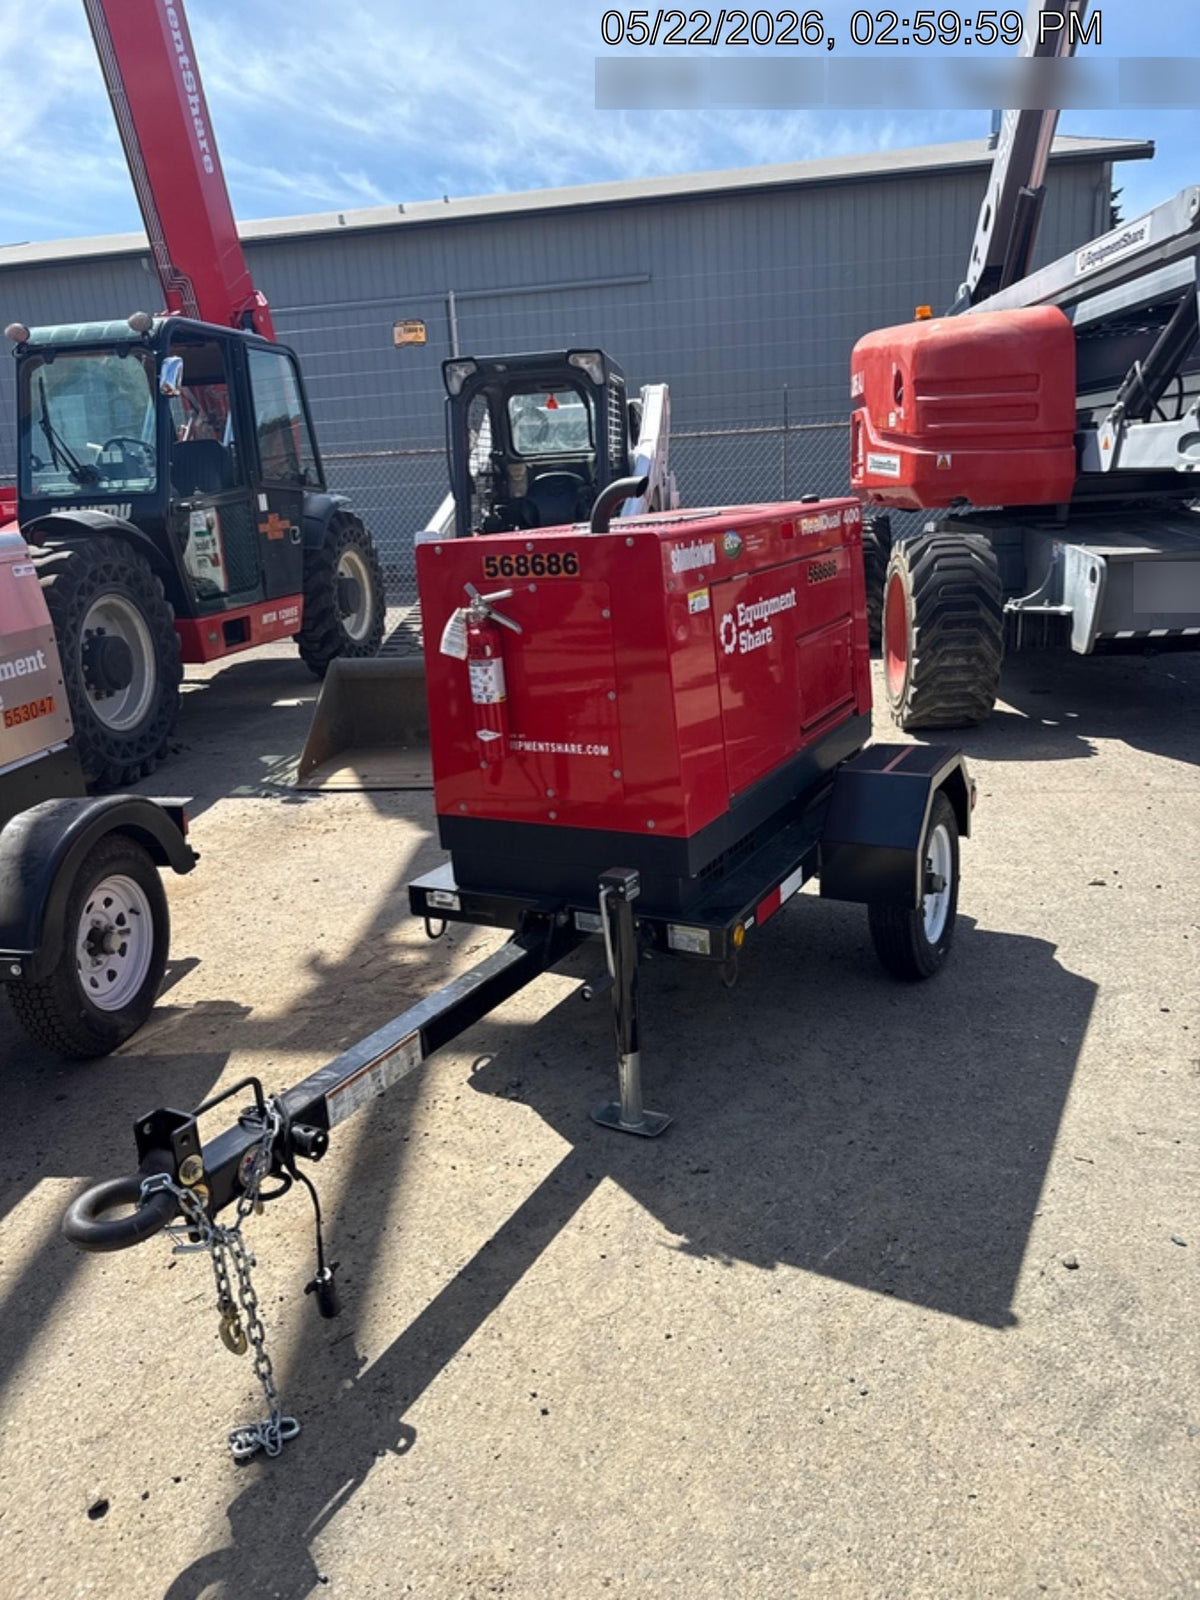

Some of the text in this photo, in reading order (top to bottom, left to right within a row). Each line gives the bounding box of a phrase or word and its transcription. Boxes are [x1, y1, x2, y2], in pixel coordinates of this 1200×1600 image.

[164, 0, 214, 174] entShare
[843, 507, 860, 525] 400
[485, 552, 578, 578] 568686
[736, 587, 798, 629] Equipment
[739, 625, 774, 655] Share
[4, 697, 54, 728] 553047
